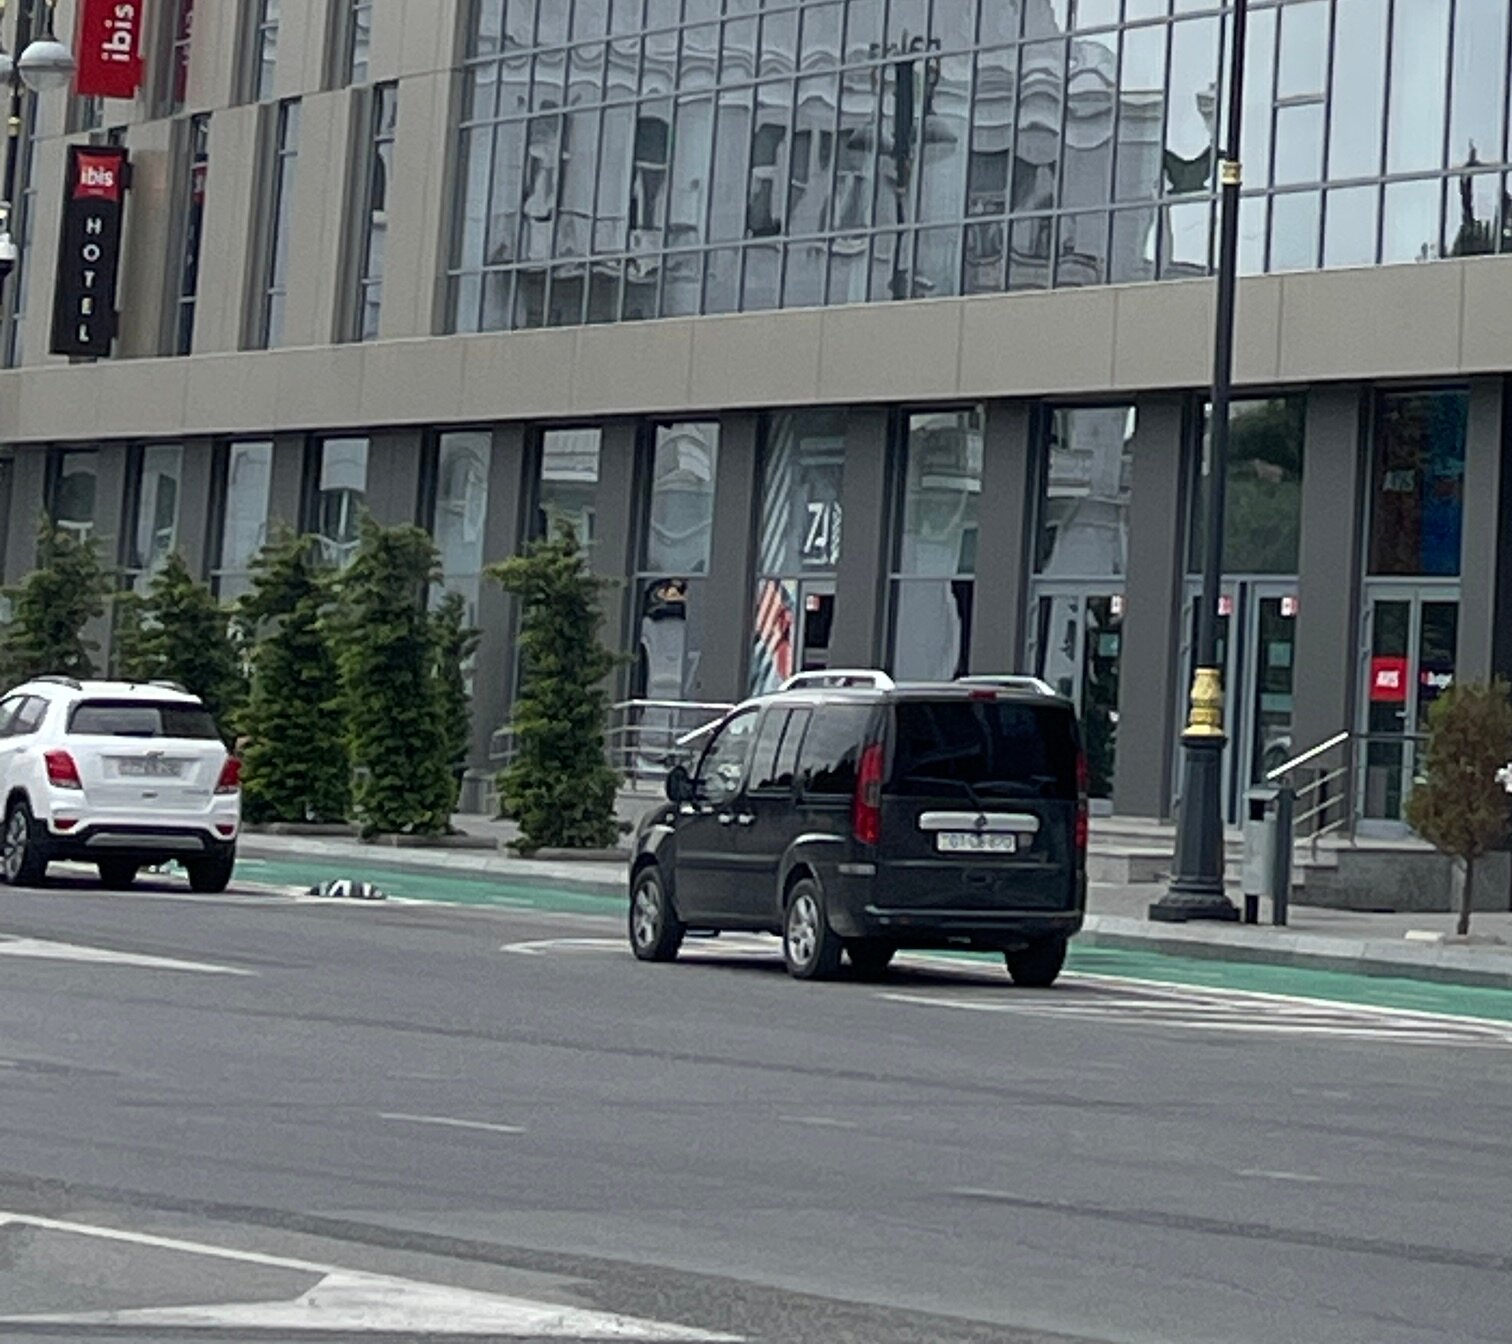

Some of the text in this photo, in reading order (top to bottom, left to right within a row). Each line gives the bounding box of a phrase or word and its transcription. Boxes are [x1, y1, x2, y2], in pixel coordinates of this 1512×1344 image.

[101, 3, 135, 62] ibis
[80, 165, 115, 187] ibis
[78, 216, 102, 343] HOTEL
